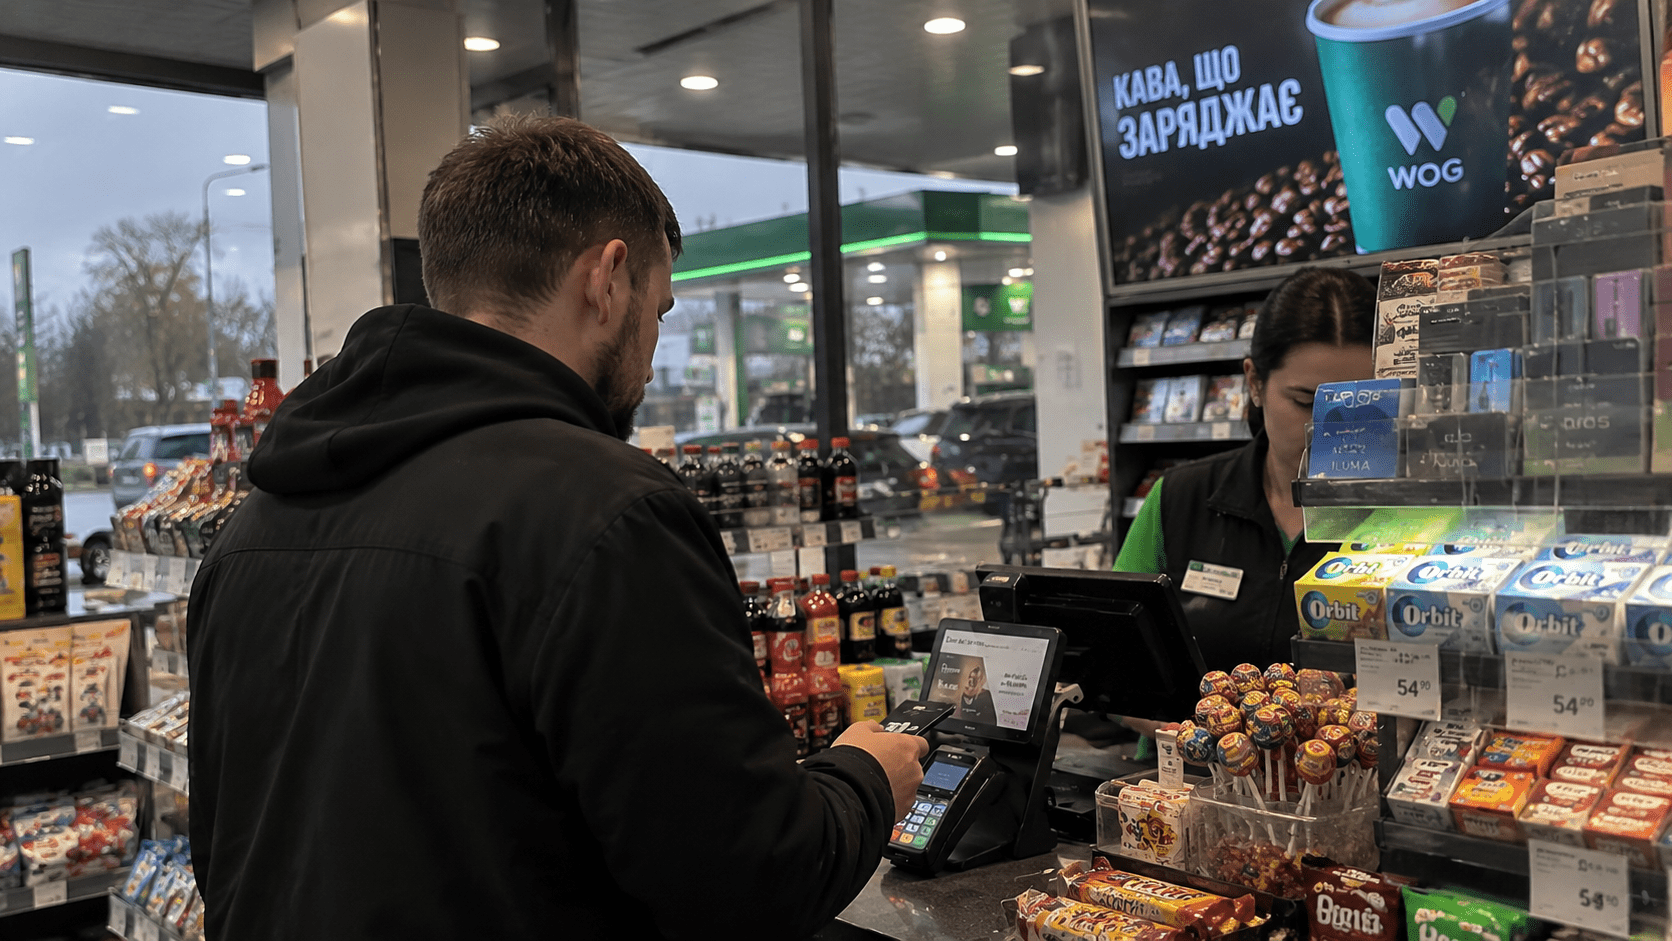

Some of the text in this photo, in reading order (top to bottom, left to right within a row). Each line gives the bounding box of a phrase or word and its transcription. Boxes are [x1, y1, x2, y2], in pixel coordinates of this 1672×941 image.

[1112, 44, 1242, 110] КАВА, ЩО
[1117, 78, 1304, 160] ЗАРЯДЖАЄ
[1387, 157, 1464, 190] WOG
[1331, 460, 1371, 471] ILUMA
[1417, 563, 1484, 581] Orbit
[1531, 569, 1601, 587] Orbit
[1309, 600, 1361, 622] Orbit
[1402, 605, 1463, 628] Orbit
[1513, 612, 1580, 636] Orbit
[1397, 678, 1419, 697] 54
[1553, 693, 1578, 716] 54
